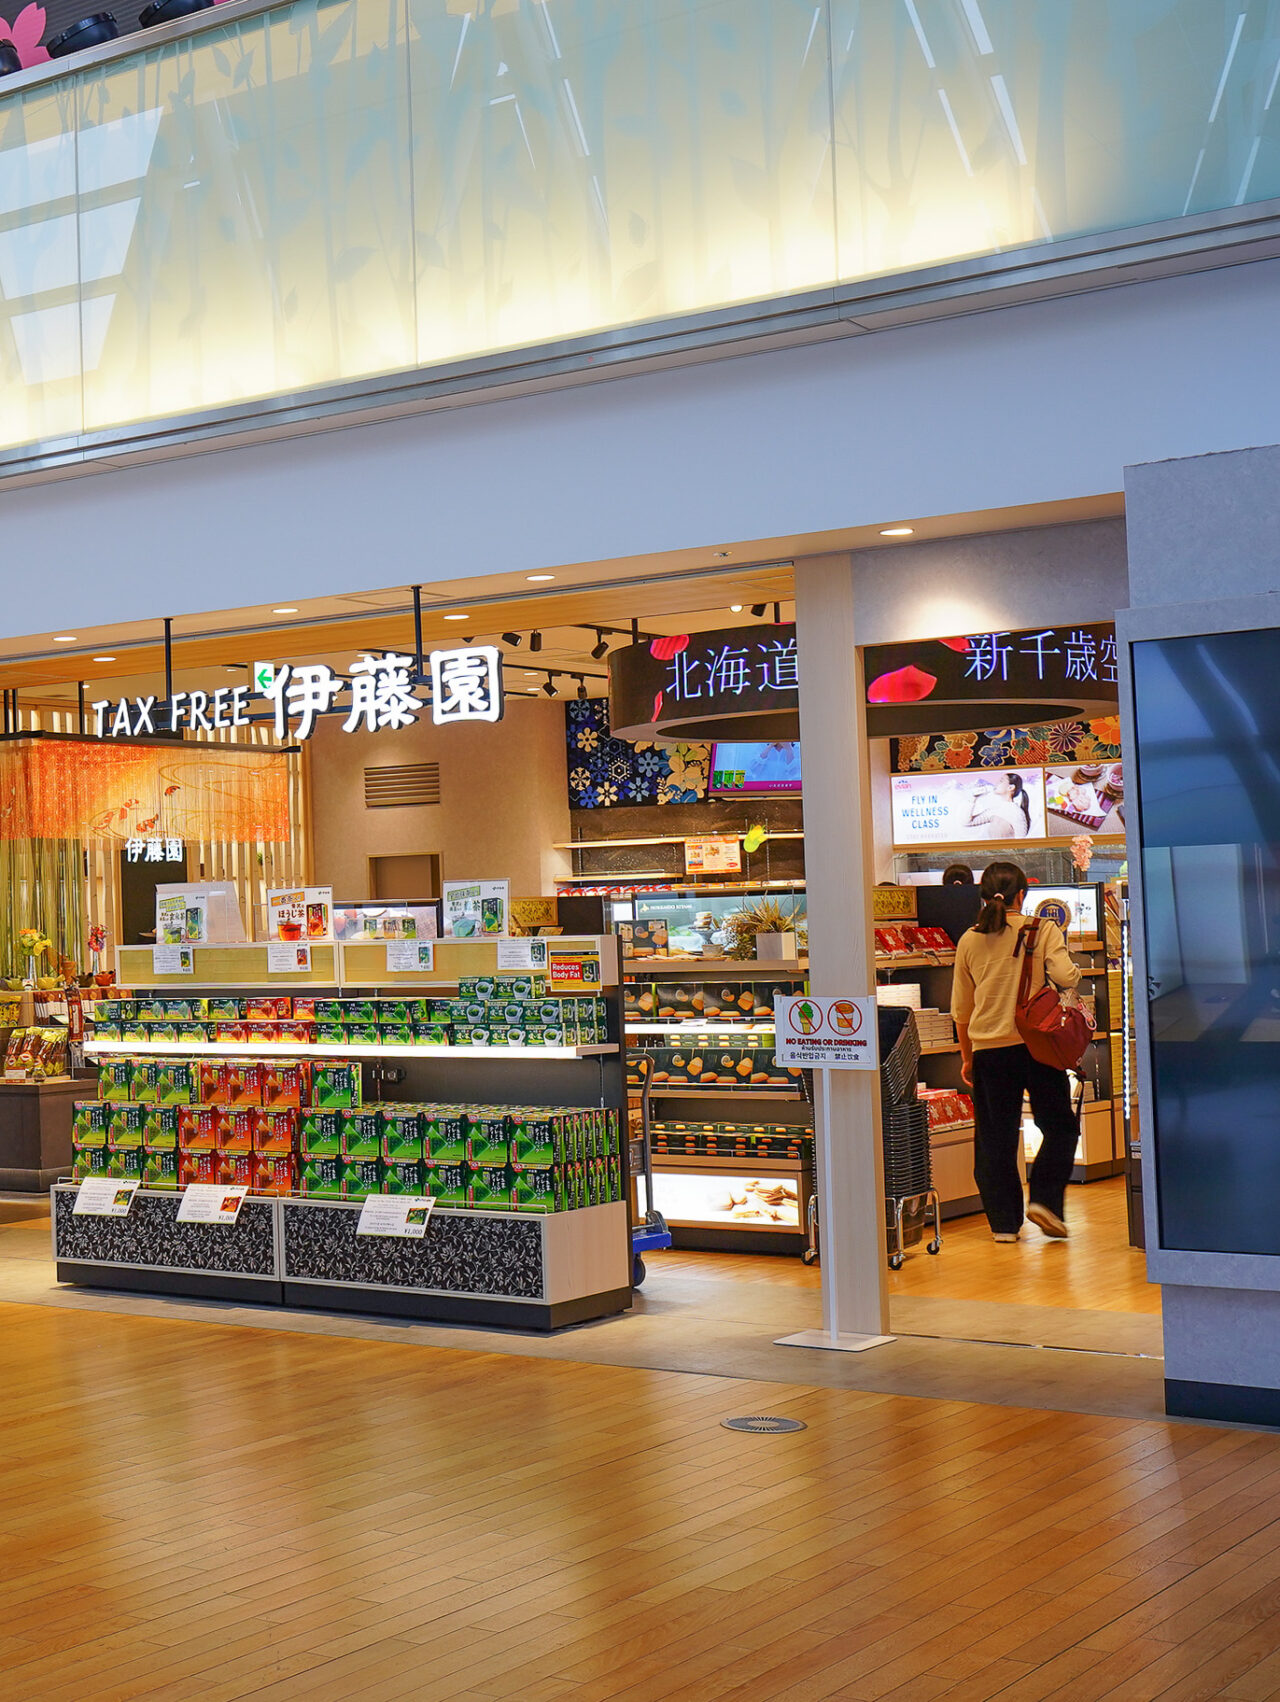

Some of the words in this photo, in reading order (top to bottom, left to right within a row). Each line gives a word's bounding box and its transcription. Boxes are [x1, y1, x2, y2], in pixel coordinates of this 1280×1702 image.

[665, 638, 799, 701] 北海道
[264, 645, 503, 740] 伊藤園
[91, 696, 156, 738] TAX
[171, 685, 251, 731] FREE
[911, 795, 926, 805] FLY
[928, 795, 938, 804] IN
[901, 806, 949, 817] WELLNESS
[911, 819, 940, 829] CLASS
[125, 837, 183, 863] 伊藤園
[552, 971, 568, 979] Body
[797, 1038, 822, 1046] EATING
[834, 1039, 868, 1047] DRINKING
